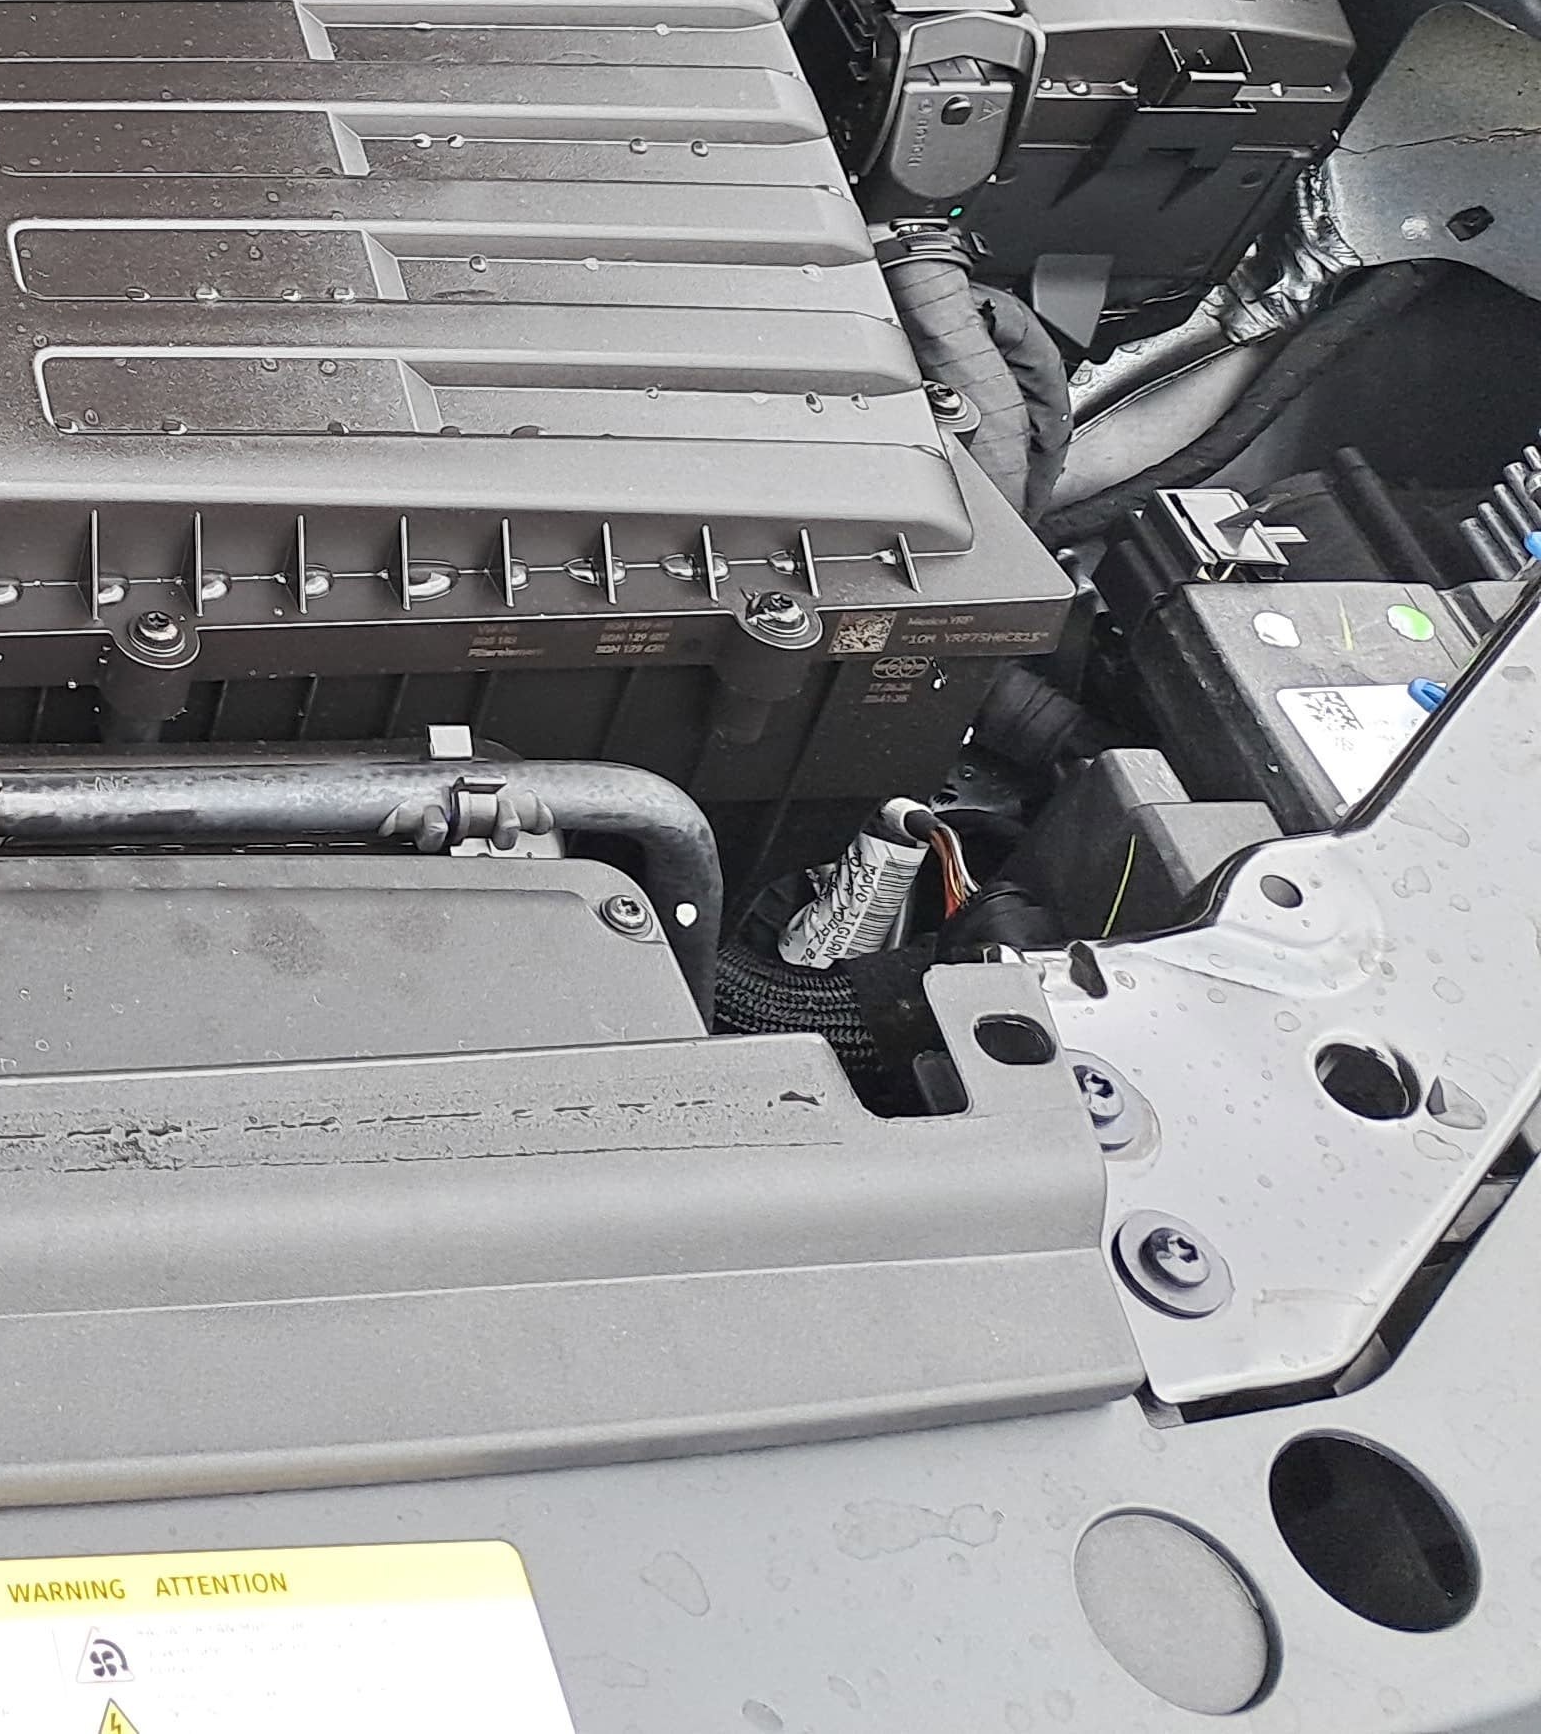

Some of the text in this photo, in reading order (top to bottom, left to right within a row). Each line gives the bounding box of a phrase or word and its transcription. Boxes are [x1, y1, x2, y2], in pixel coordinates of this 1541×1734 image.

[822, 911, 860, 959] TIGUAN
[7, 1572, 288, 1604] WARNING ATTENTION
